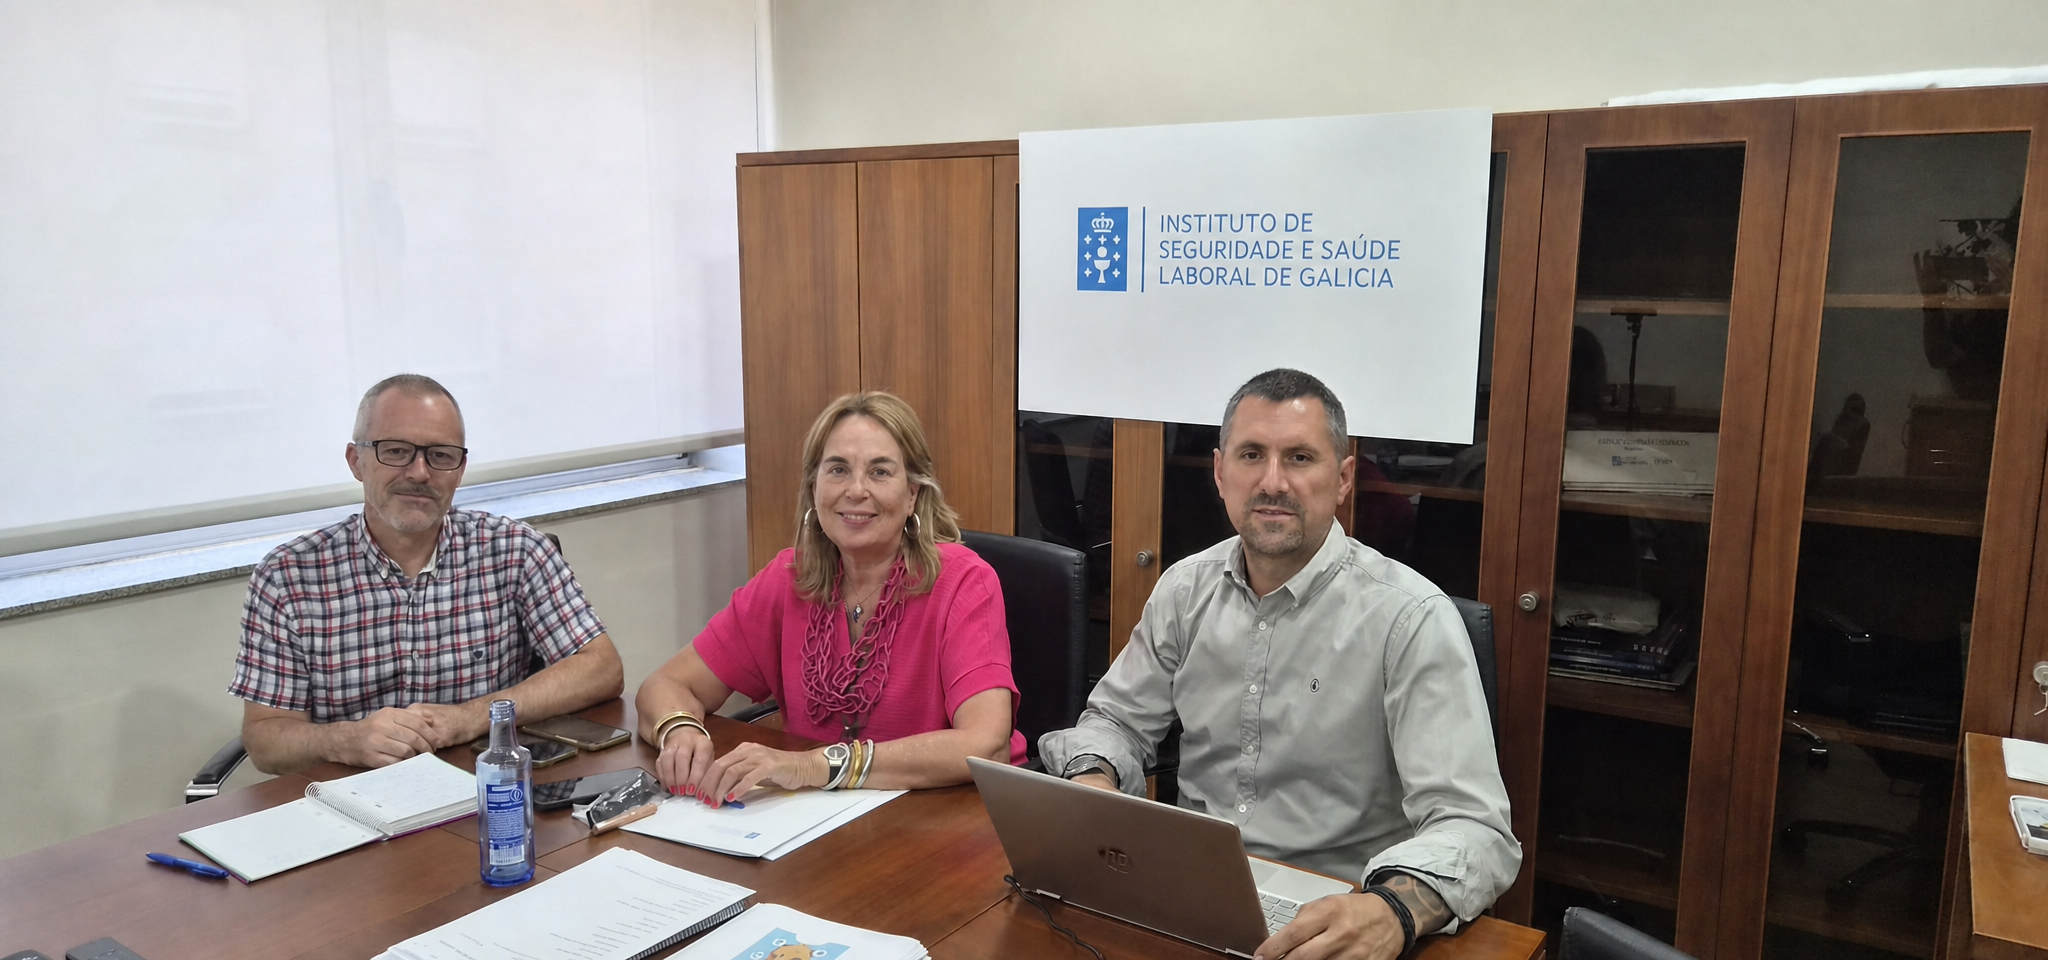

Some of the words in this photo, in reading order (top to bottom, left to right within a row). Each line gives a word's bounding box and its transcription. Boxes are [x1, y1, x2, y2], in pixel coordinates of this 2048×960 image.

[1160, 212, 1277, 233] INSTITUTO
[1284, 212, 1313, 233] DE
[1159, 239, 1294, 260] SEGURIDADE
[1302, 239, 1314, 260] E
[1321, 233, 1401, 261] SAÚDE
[1159, 266, 1256, 286] LABORAL
[1264, 267, 1292, 287] DE
[1300, 267, 1394, 289] GALICIA
